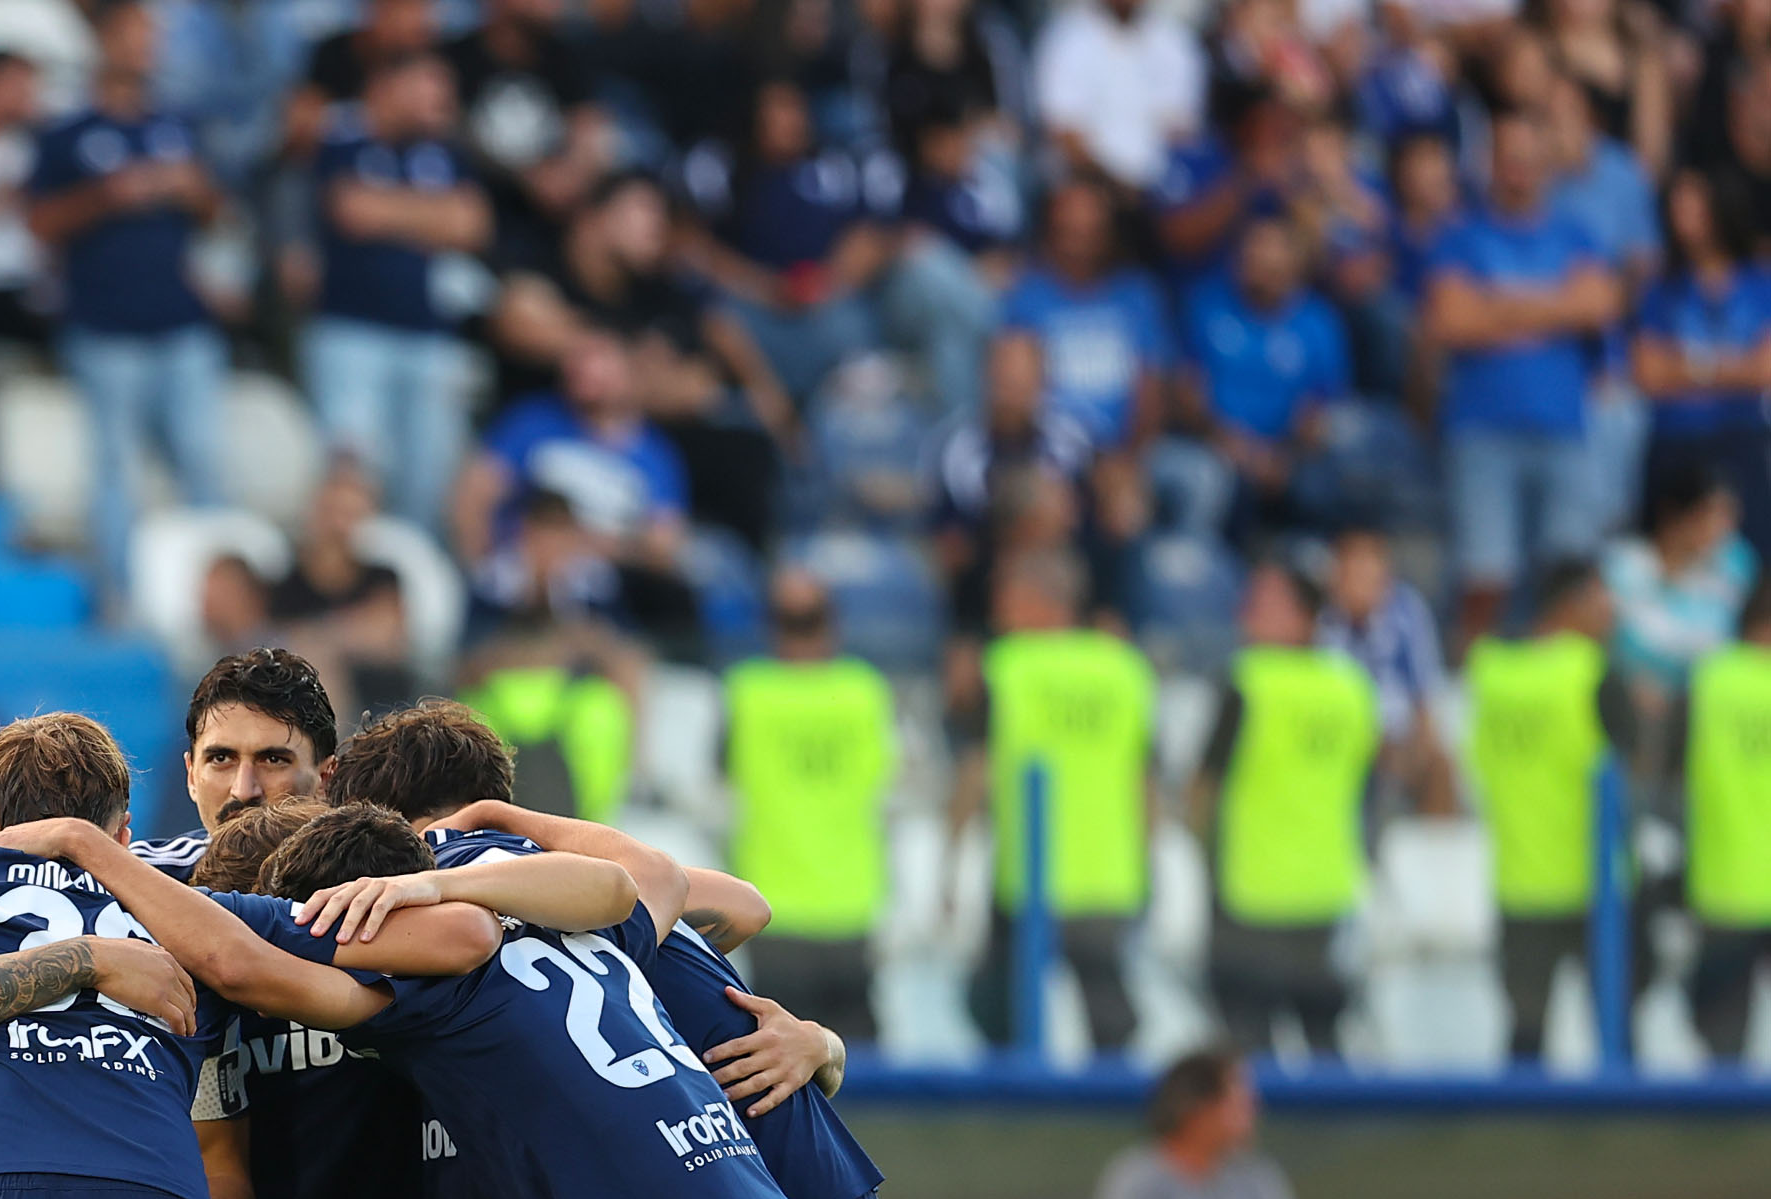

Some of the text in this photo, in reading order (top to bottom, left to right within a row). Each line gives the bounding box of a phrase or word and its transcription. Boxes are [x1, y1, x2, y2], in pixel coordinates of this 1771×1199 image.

[500, 932, 711, 1088] 22
[10, 1051, 157, 1082] SOLID TADING
[684, 1148, 723, 1172] SOLID
